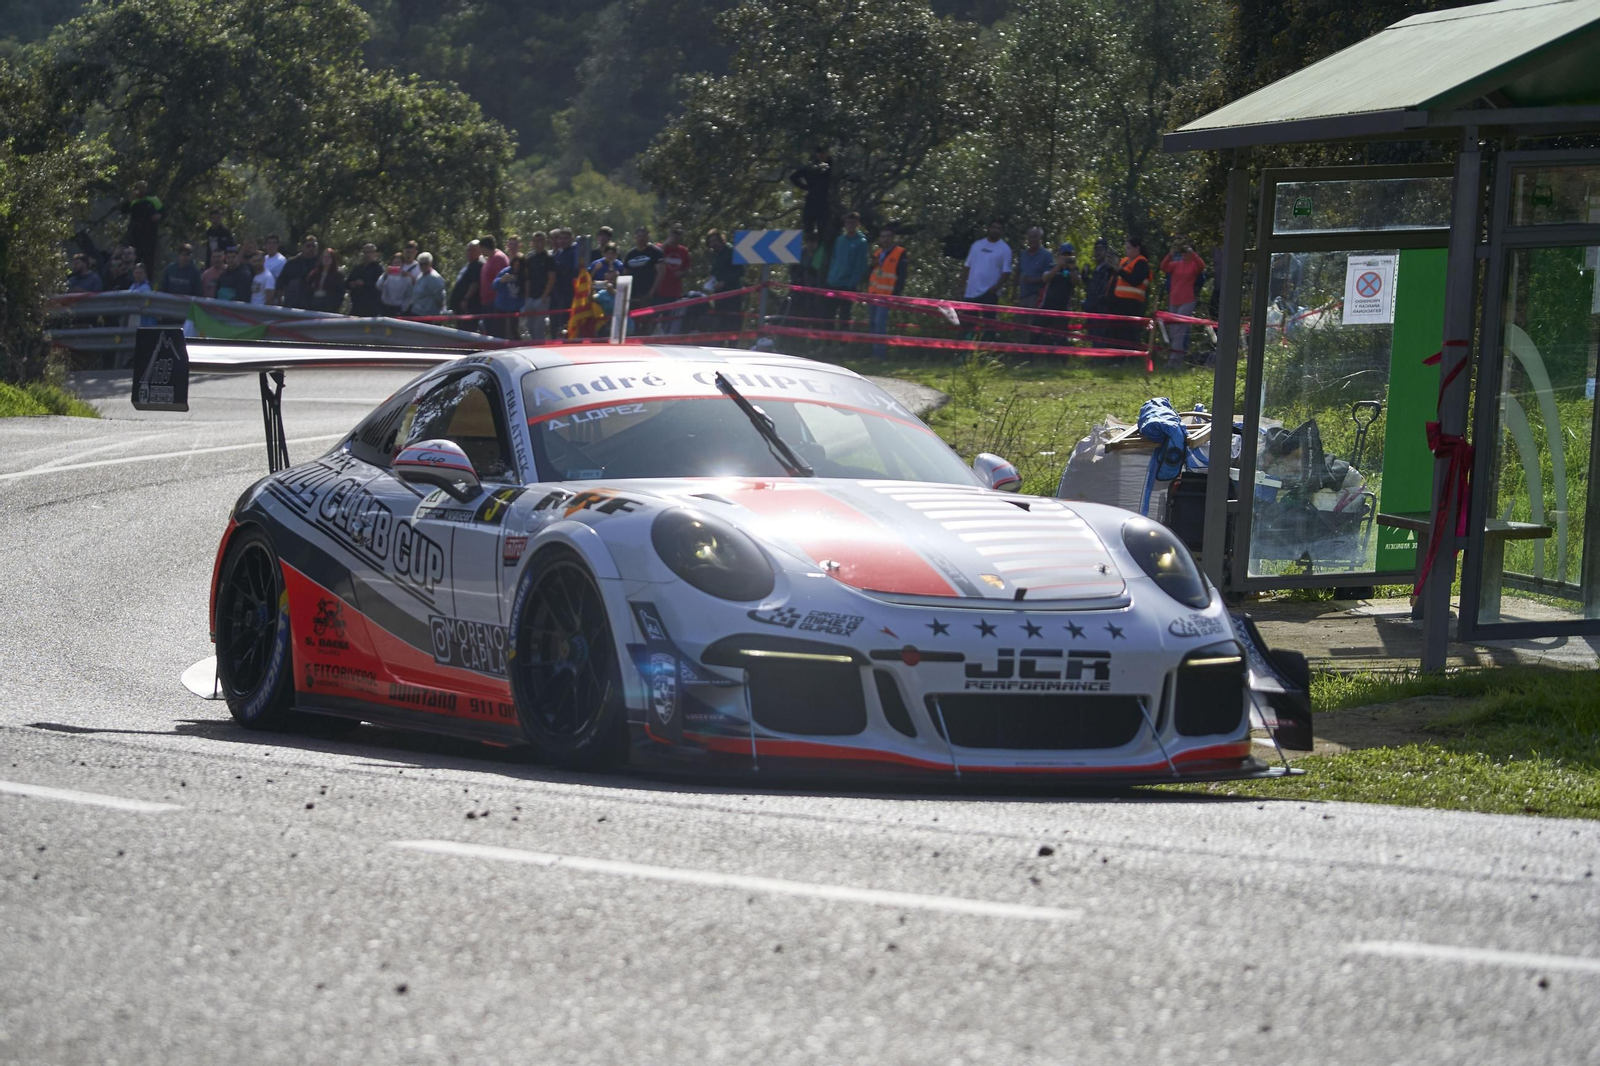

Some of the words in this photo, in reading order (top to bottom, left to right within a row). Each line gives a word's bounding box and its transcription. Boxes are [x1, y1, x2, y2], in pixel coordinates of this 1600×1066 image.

[533, 371, 667, 407] André
[506, 389, 518, 421] FULL
[572, 402, 647, 423] LOPEZ
[417, 452, 445, 463] Cup
[511, 423, 529, 475] ATTACK
[319, 479, 393, 561] CLIMB
[393, 519, 444, 595] CUP
[799, 624, 855, 637] GUADIX
[809, 610, 865, 621] CIRCUITO
[448, 620, 505, 650] MORENO
[246, 638, 283, 718] MICHELIN
[965, 648, 1111, 680] JCR
[965, 681, 1111, 691] PERFORMANCE
[470, 698, 493, 715] 911
